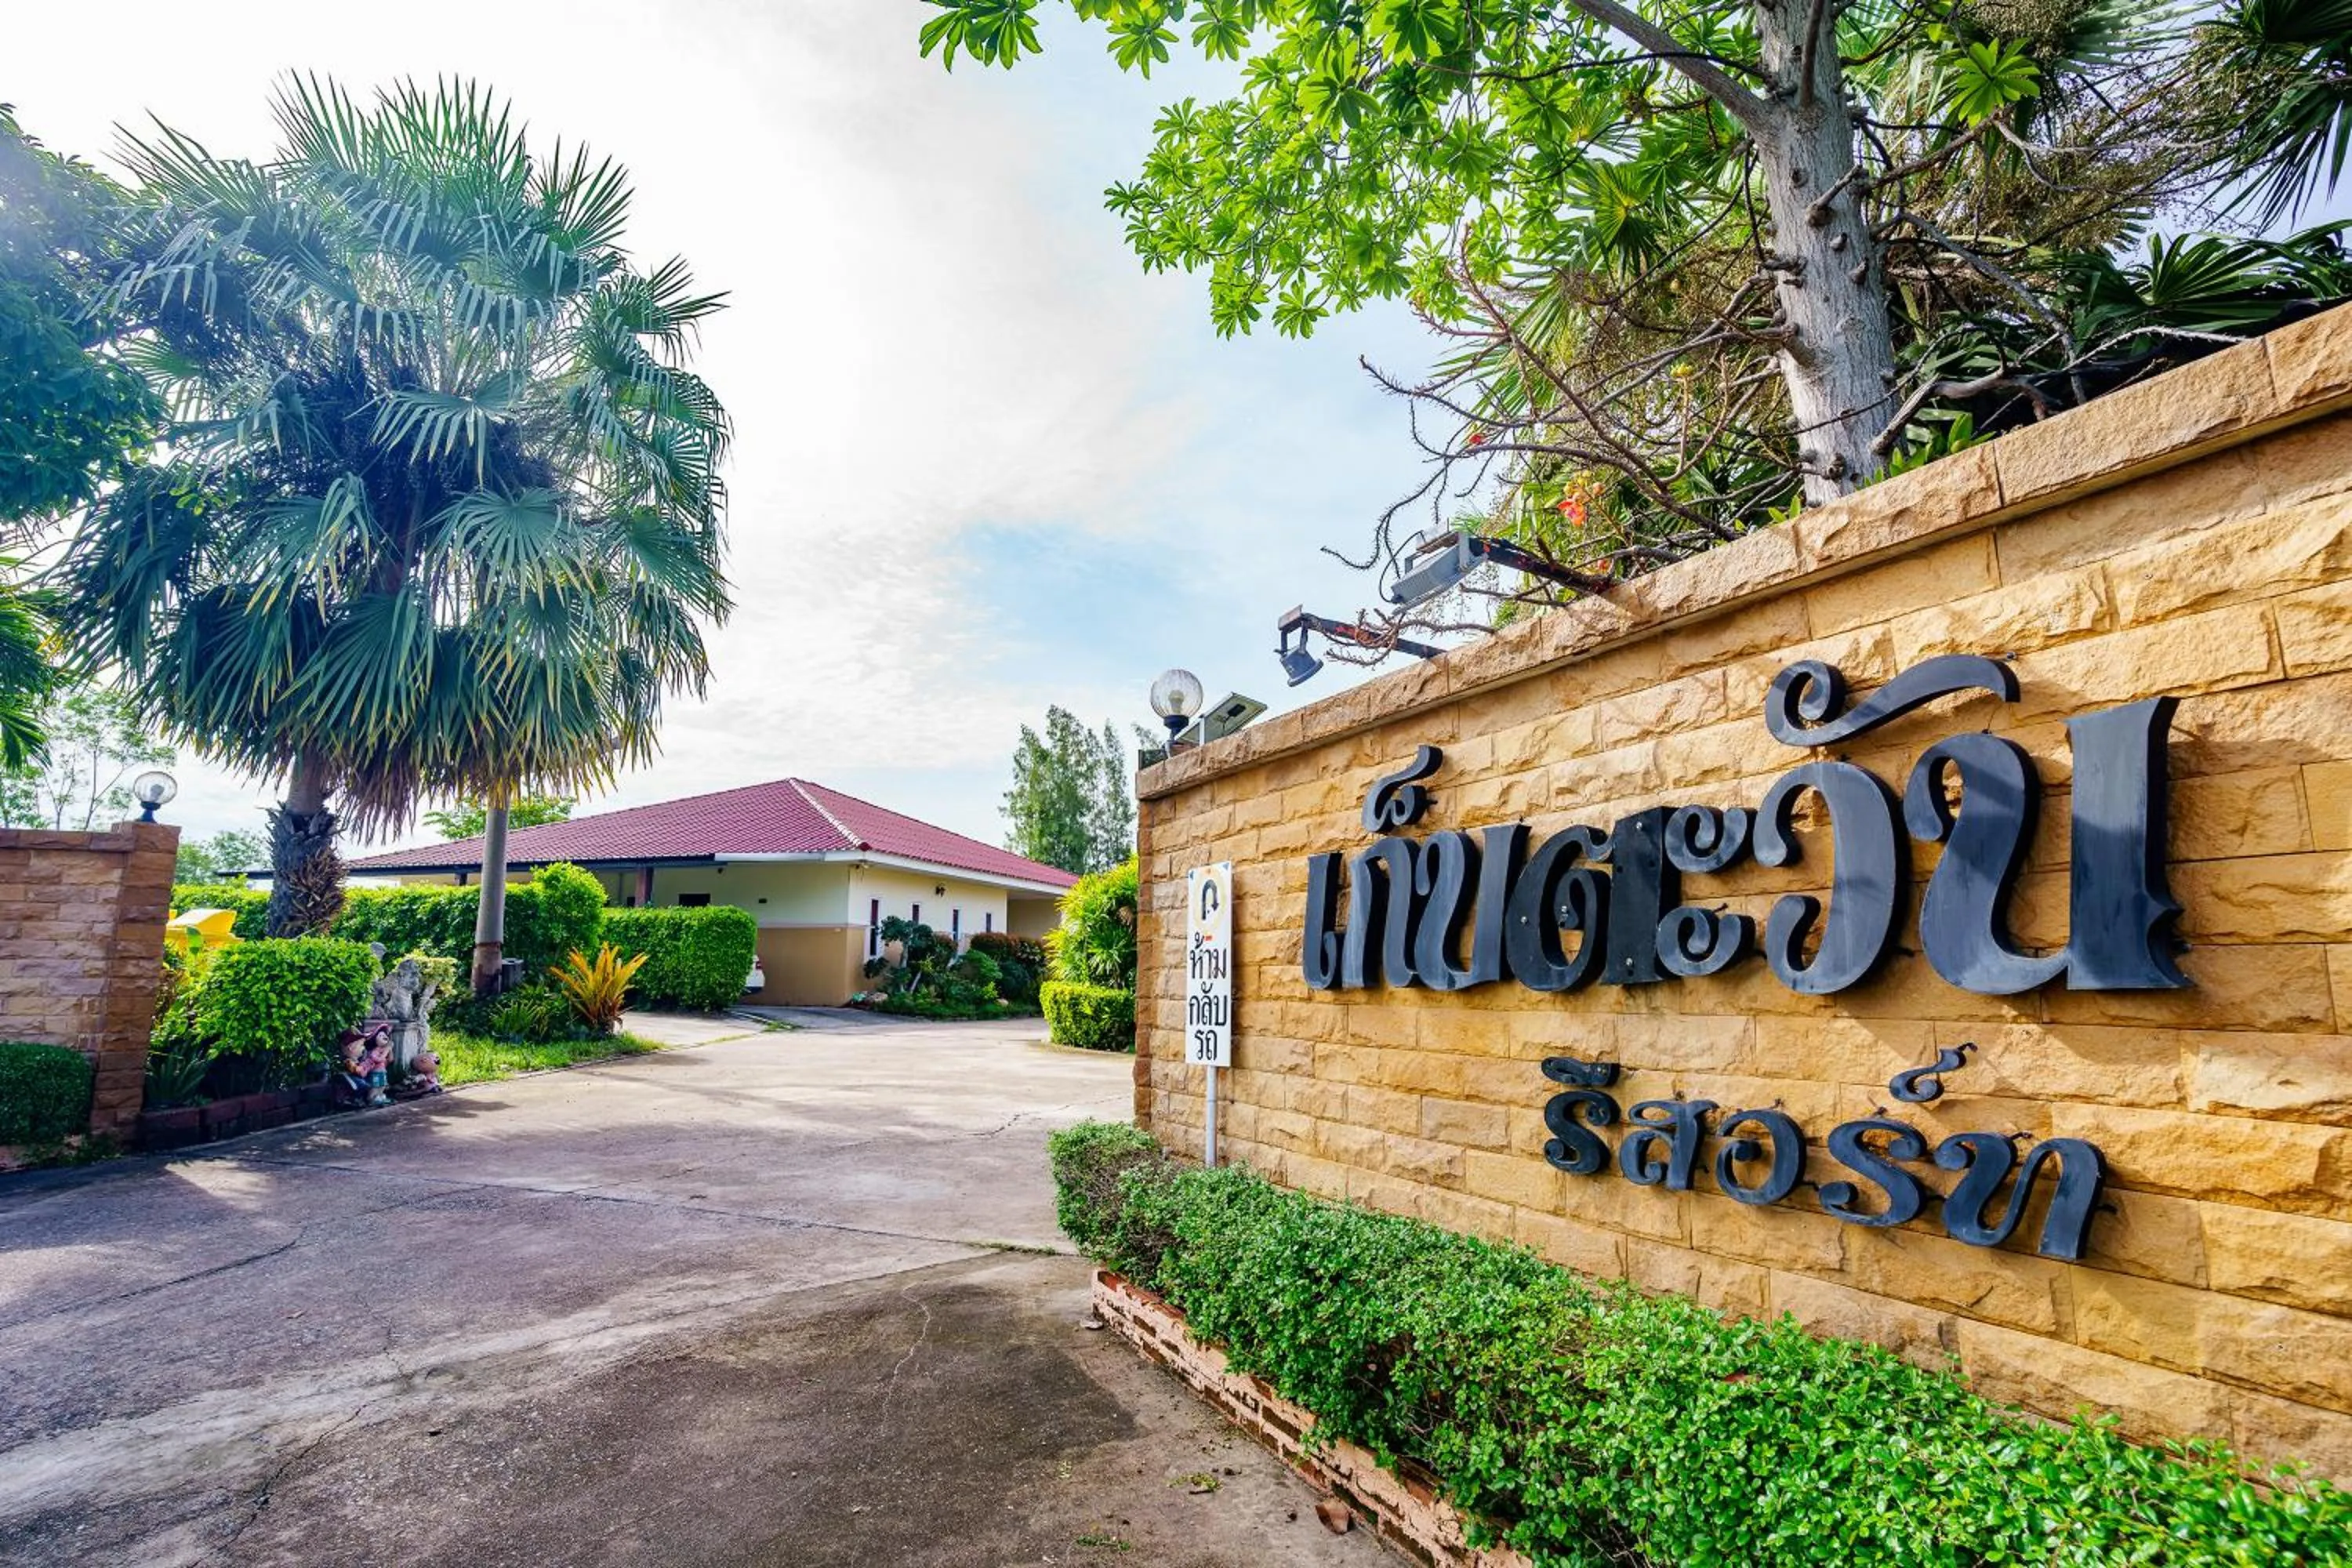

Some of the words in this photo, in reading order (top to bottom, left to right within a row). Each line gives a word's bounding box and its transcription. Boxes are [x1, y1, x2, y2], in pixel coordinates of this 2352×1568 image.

[1303, 655, 2186, 995] เก็บตะวัน
[1190, 931, 1227, 978] ห้าม
[1189, 981, 1228, 1026] กลับ
[1194, 1029, 1218, 1061] รถ
